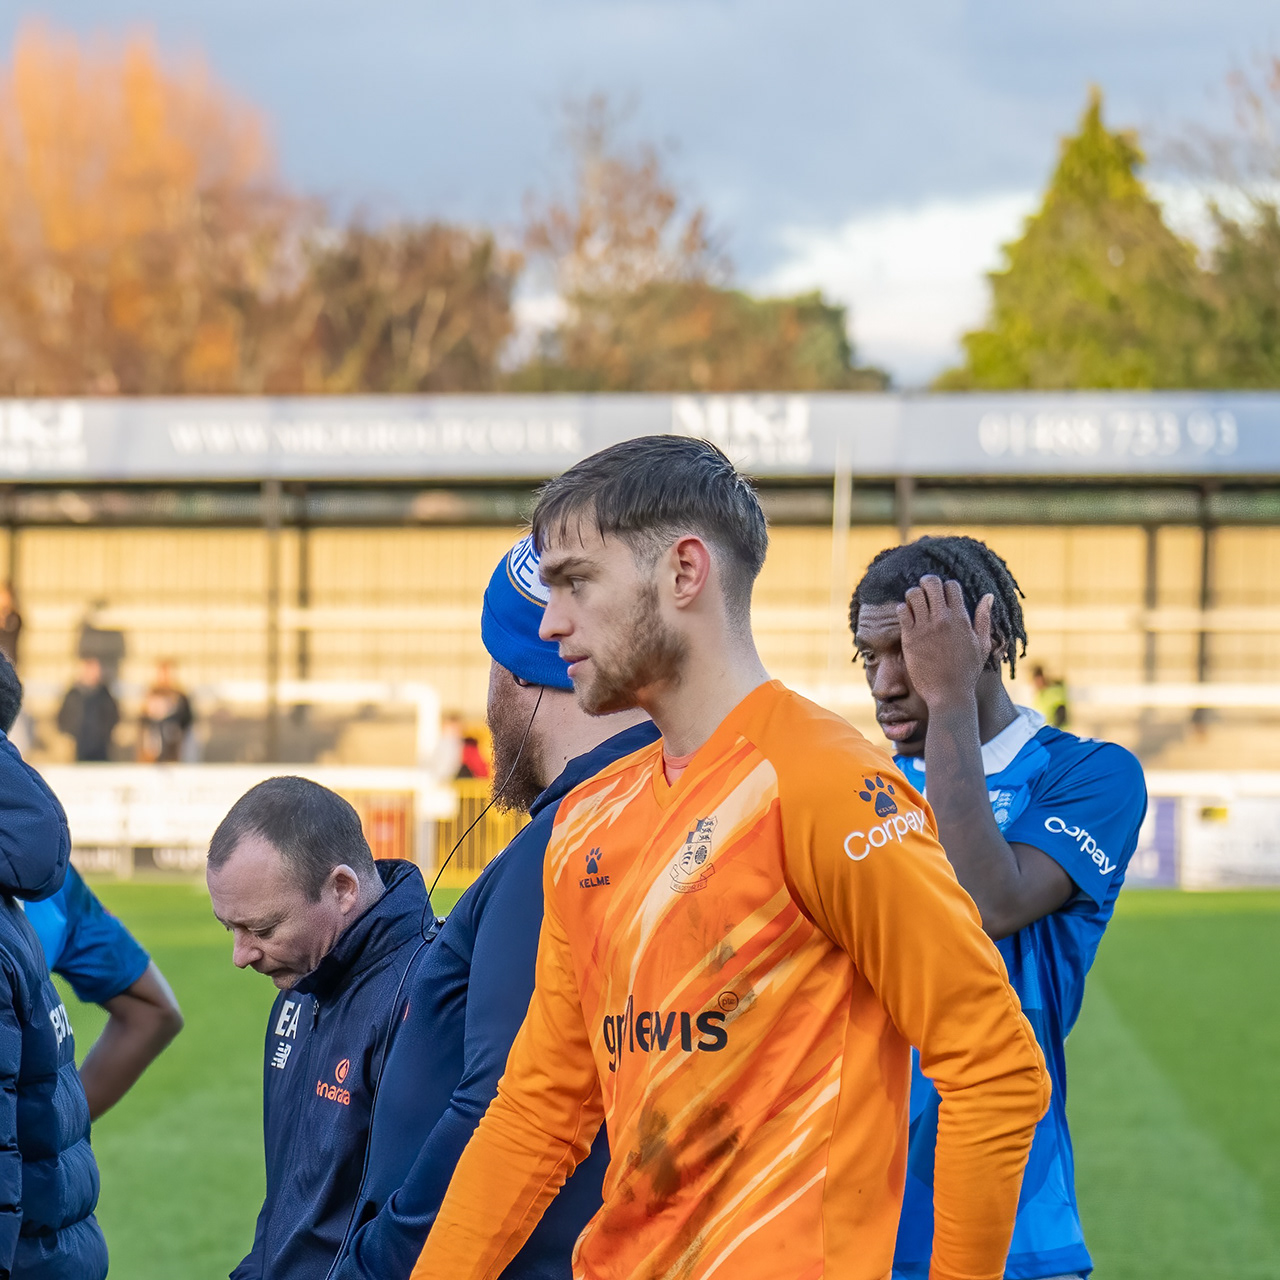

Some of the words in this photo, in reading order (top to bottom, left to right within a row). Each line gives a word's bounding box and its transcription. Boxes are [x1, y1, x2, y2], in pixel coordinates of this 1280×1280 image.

[843, 808, 926, 861] Corpay
[579, 876, 611, 889] KELME
[274, 999, 302, 1040] EA
